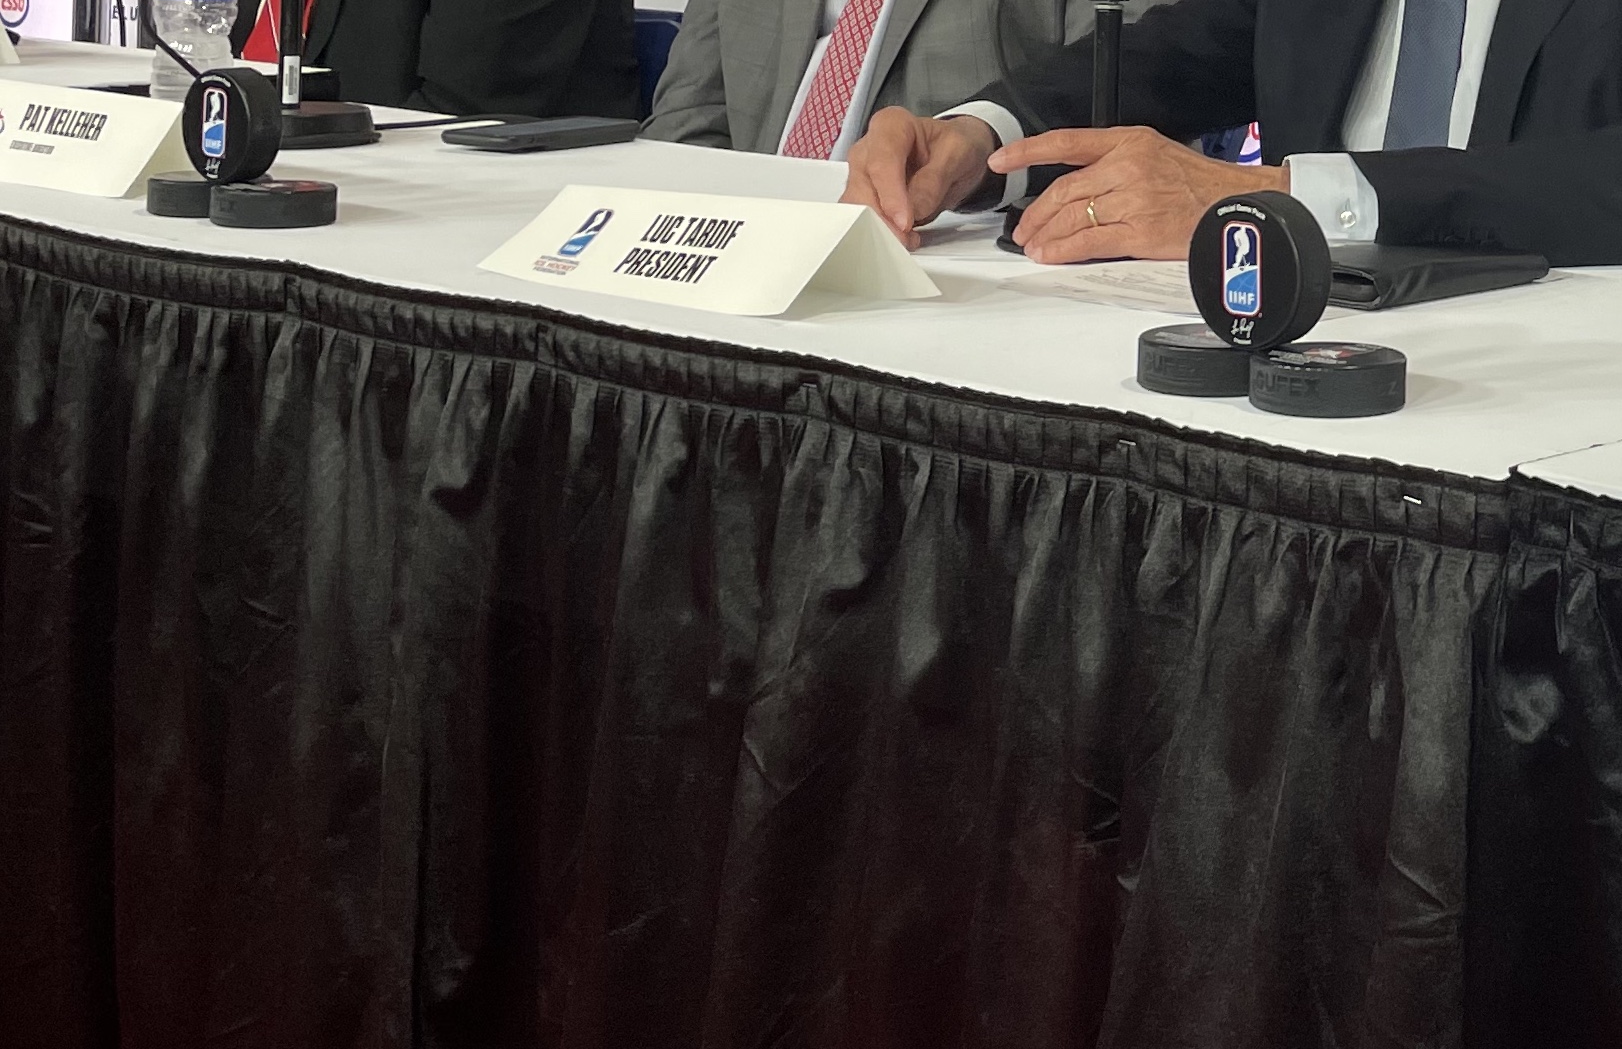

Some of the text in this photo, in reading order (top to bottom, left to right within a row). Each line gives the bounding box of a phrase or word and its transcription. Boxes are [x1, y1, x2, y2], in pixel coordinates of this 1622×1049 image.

[19, 104, 108, 141] PAT KELLEHER
[640, 214, 745, 250] LUC TARDIF
[613, 247, 719, 284] PRESIDENT
[1228, 290, 1255, 306] IIHF
